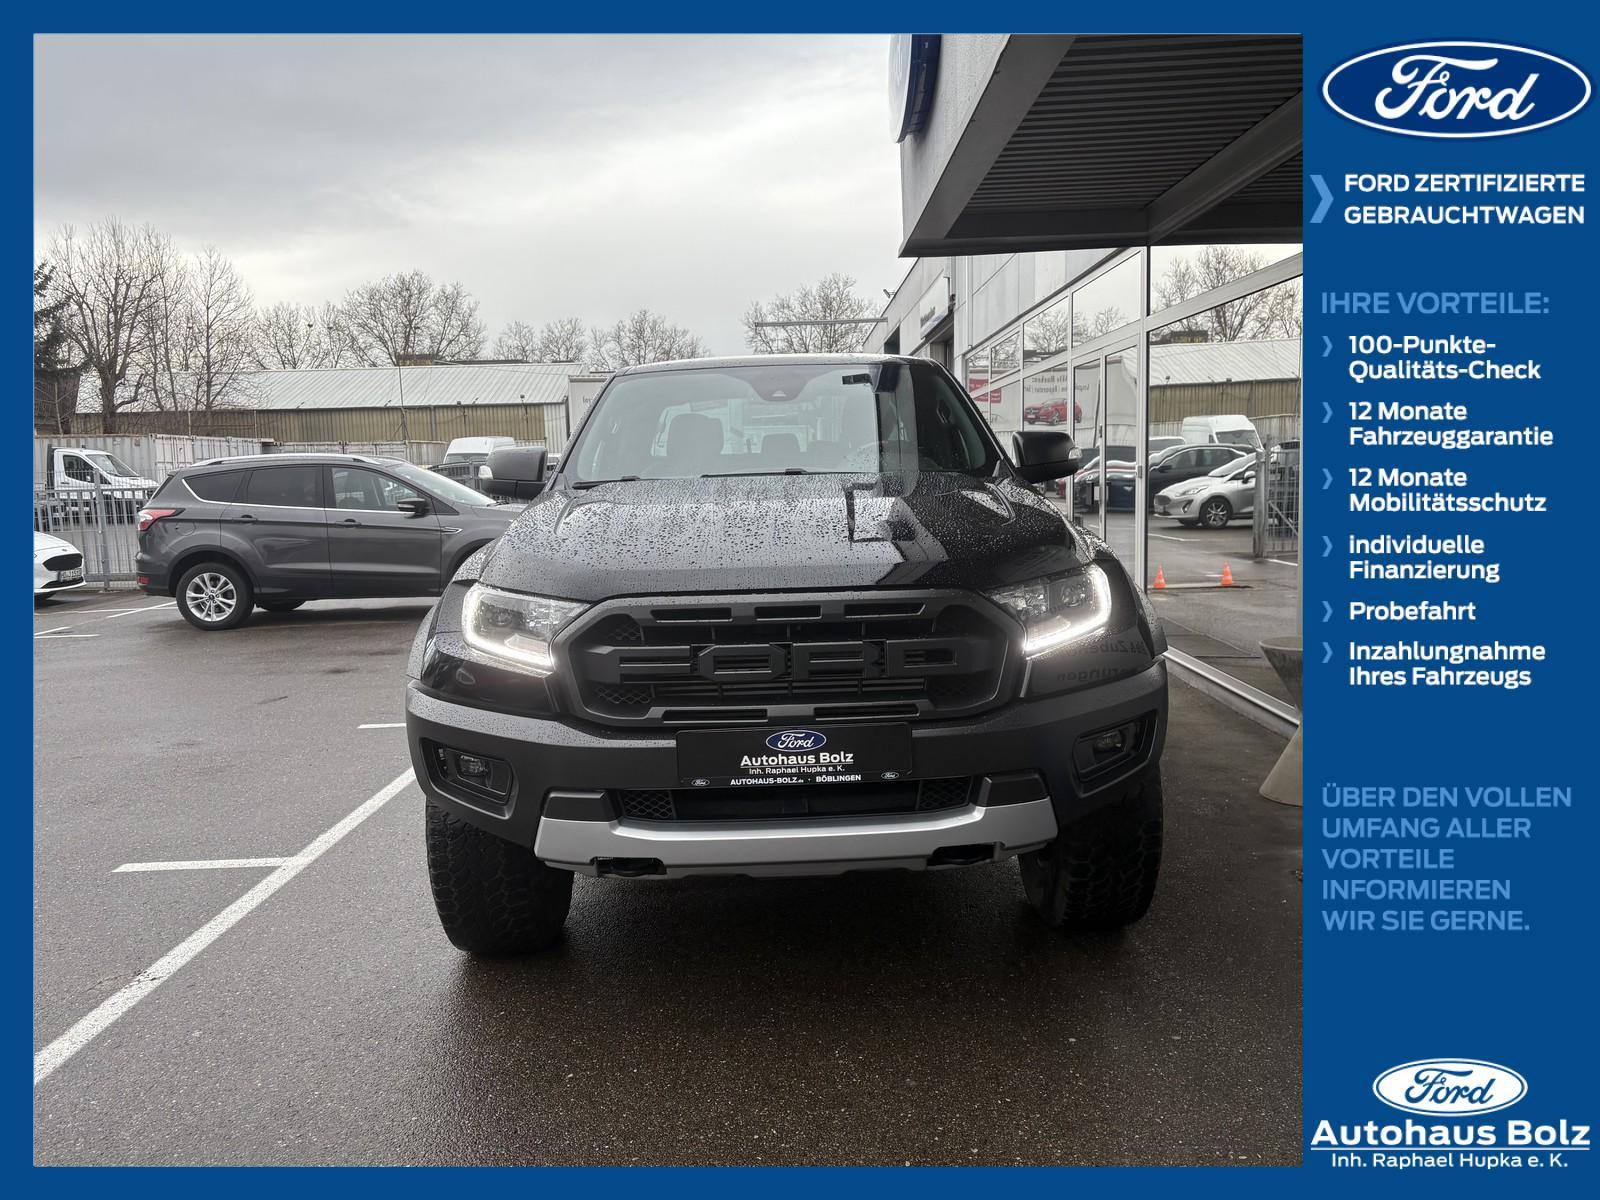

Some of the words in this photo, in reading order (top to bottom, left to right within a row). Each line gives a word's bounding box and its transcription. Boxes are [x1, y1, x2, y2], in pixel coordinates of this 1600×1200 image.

[777, 732, 815, 749] Ford
[740, 753, 816, 767] Autohaus
[819, 751, 854, 763] Bolz
[765, 766, 799, 775] Raphael
[800, 765, 827, 774] Hupka
[815, 774, 862, 783] BÖBLINGEN
